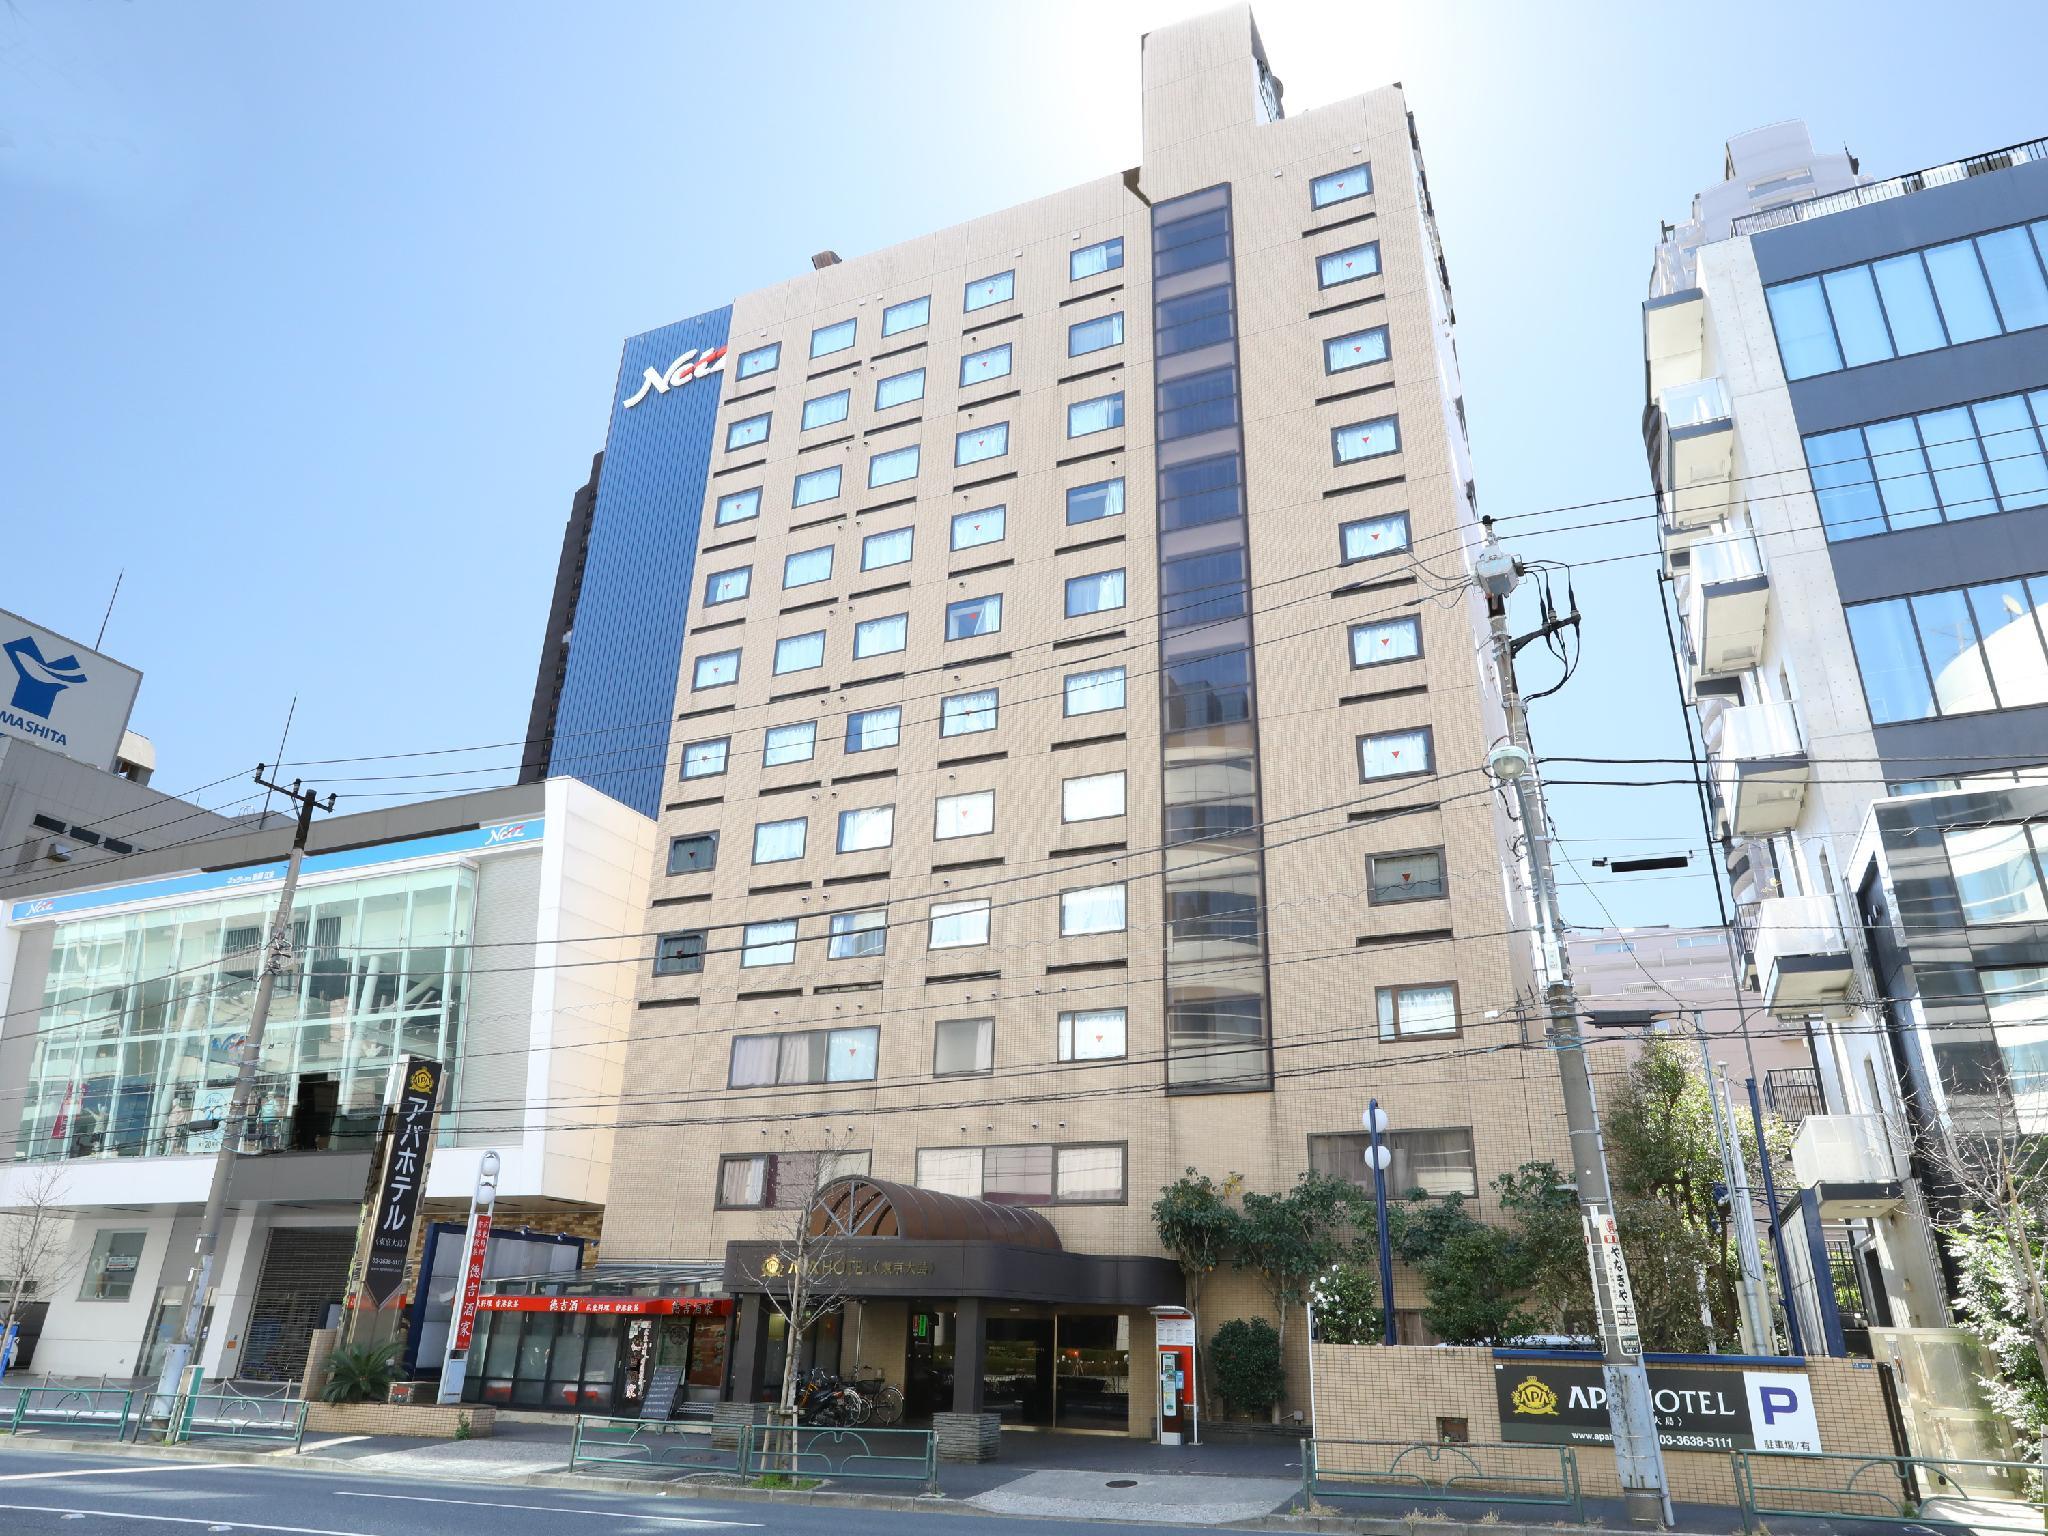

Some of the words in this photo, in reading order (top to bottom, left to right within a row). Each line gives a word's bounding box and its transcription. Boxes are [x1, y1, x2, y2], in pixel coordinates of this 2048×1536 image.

[383, 1096, 428, 1231] アパホテル
[1568, 1385, 1610, 1410] AP
[1759, 1386, 1798, 1425] P
[1659, 1434, 1732, 1448] 03-3638-5111
